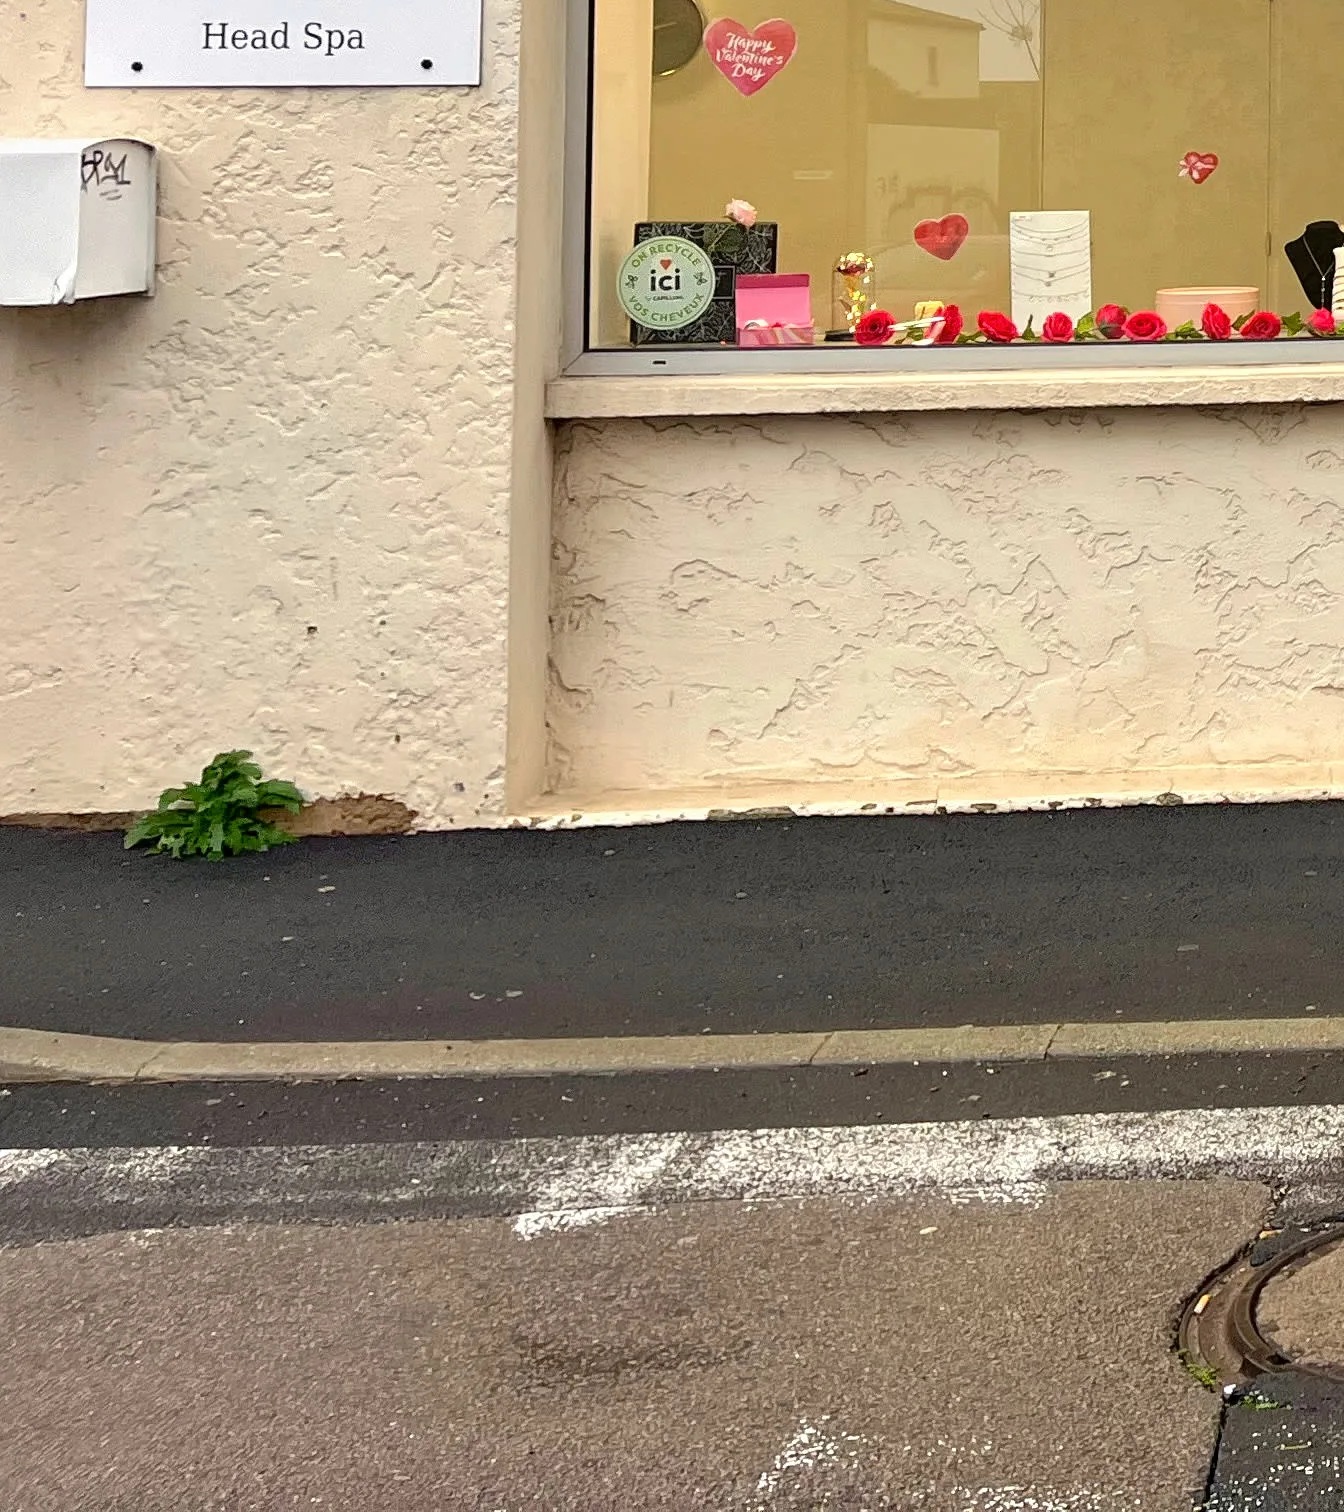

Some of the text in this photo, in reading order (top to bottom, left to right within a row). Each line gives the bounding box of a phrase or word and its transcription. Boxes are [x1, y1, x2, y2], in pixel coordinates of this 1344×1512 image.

[202, 21, 365, 56] Head Spa
[726, 32, 776, 53] Happy
[716, 48, 783, 66] Valentine's
[731, 63, 766, 81] Day
[631, 243, 701, 268] ON RECYCLE
[650, 268, 680, 291] ici
[629, 293, 704, 321] VOS CHEVEUX
